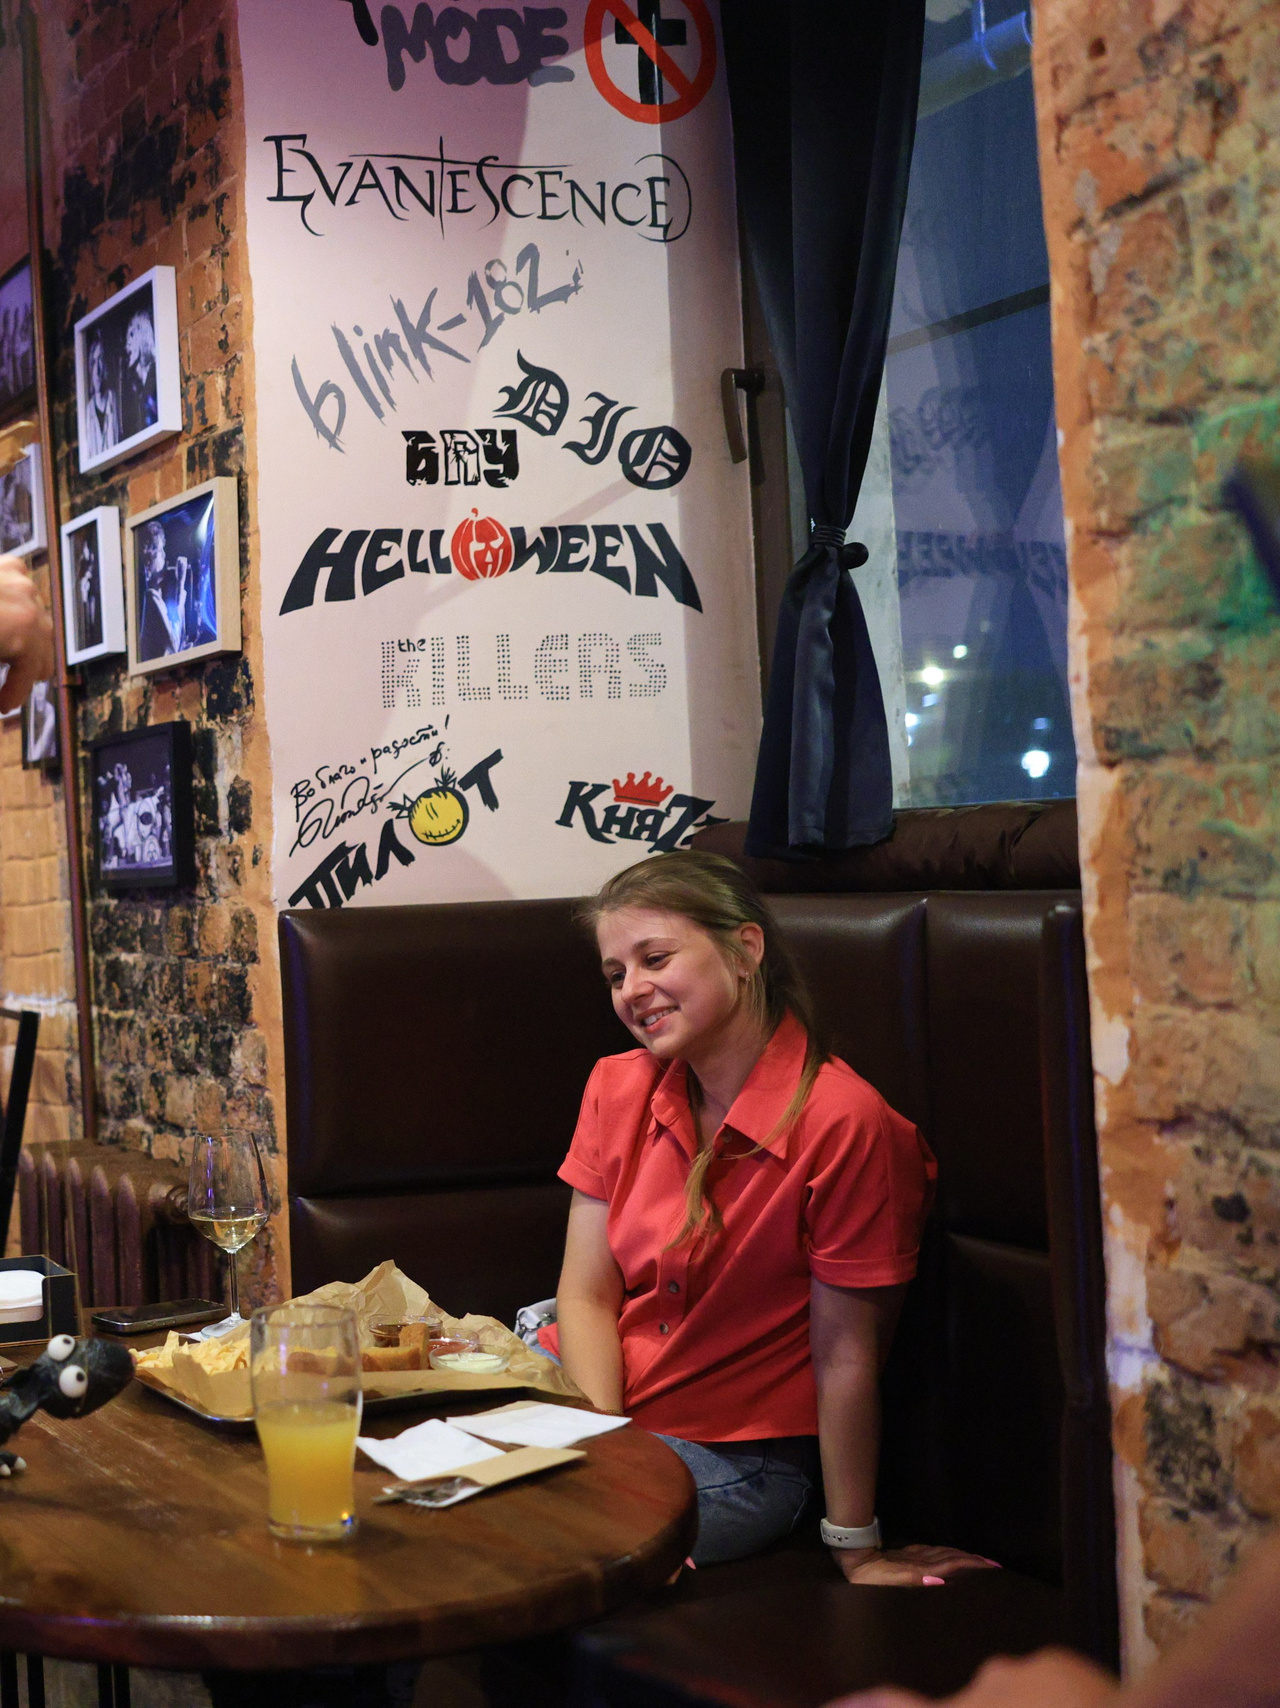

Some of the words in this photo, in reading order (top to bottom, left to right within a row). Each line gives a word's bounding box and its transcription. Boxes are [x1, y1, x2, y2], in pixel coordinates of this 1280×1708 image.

[381, 3, 575, 91] MODE
[492, 348, 692, 490] DIO
[279, 508, 703, 616] HELLOWEEN
[398, 638, 426, 652] the
